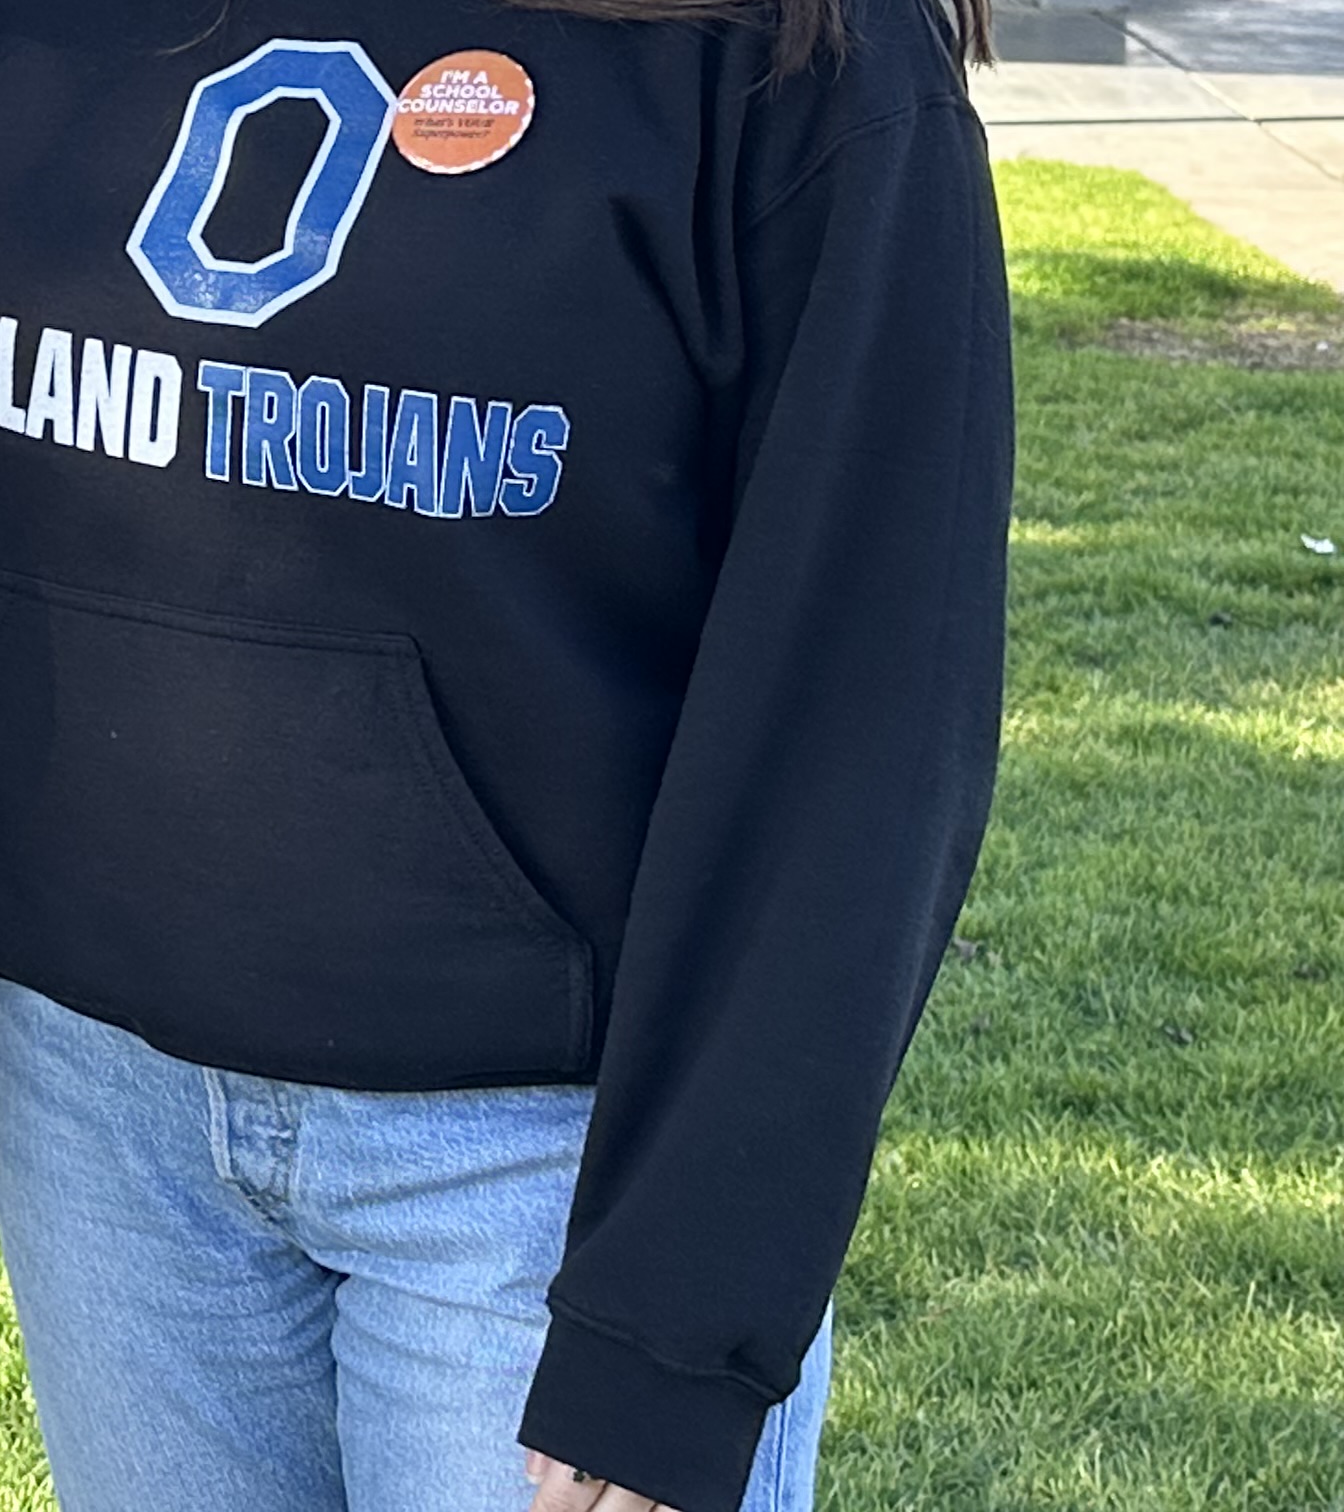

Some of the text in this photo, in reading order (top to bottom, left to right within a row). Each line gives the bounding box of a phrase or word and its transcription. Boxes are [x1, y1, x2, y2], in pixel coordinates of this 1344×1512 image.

[441, 70, 488, 84] I'M A
[421, 83, 503, 99] SCHOOL
[399, 99, 519, 114] COUNSELOR
[197, 359, 572, 519] TROJANS
